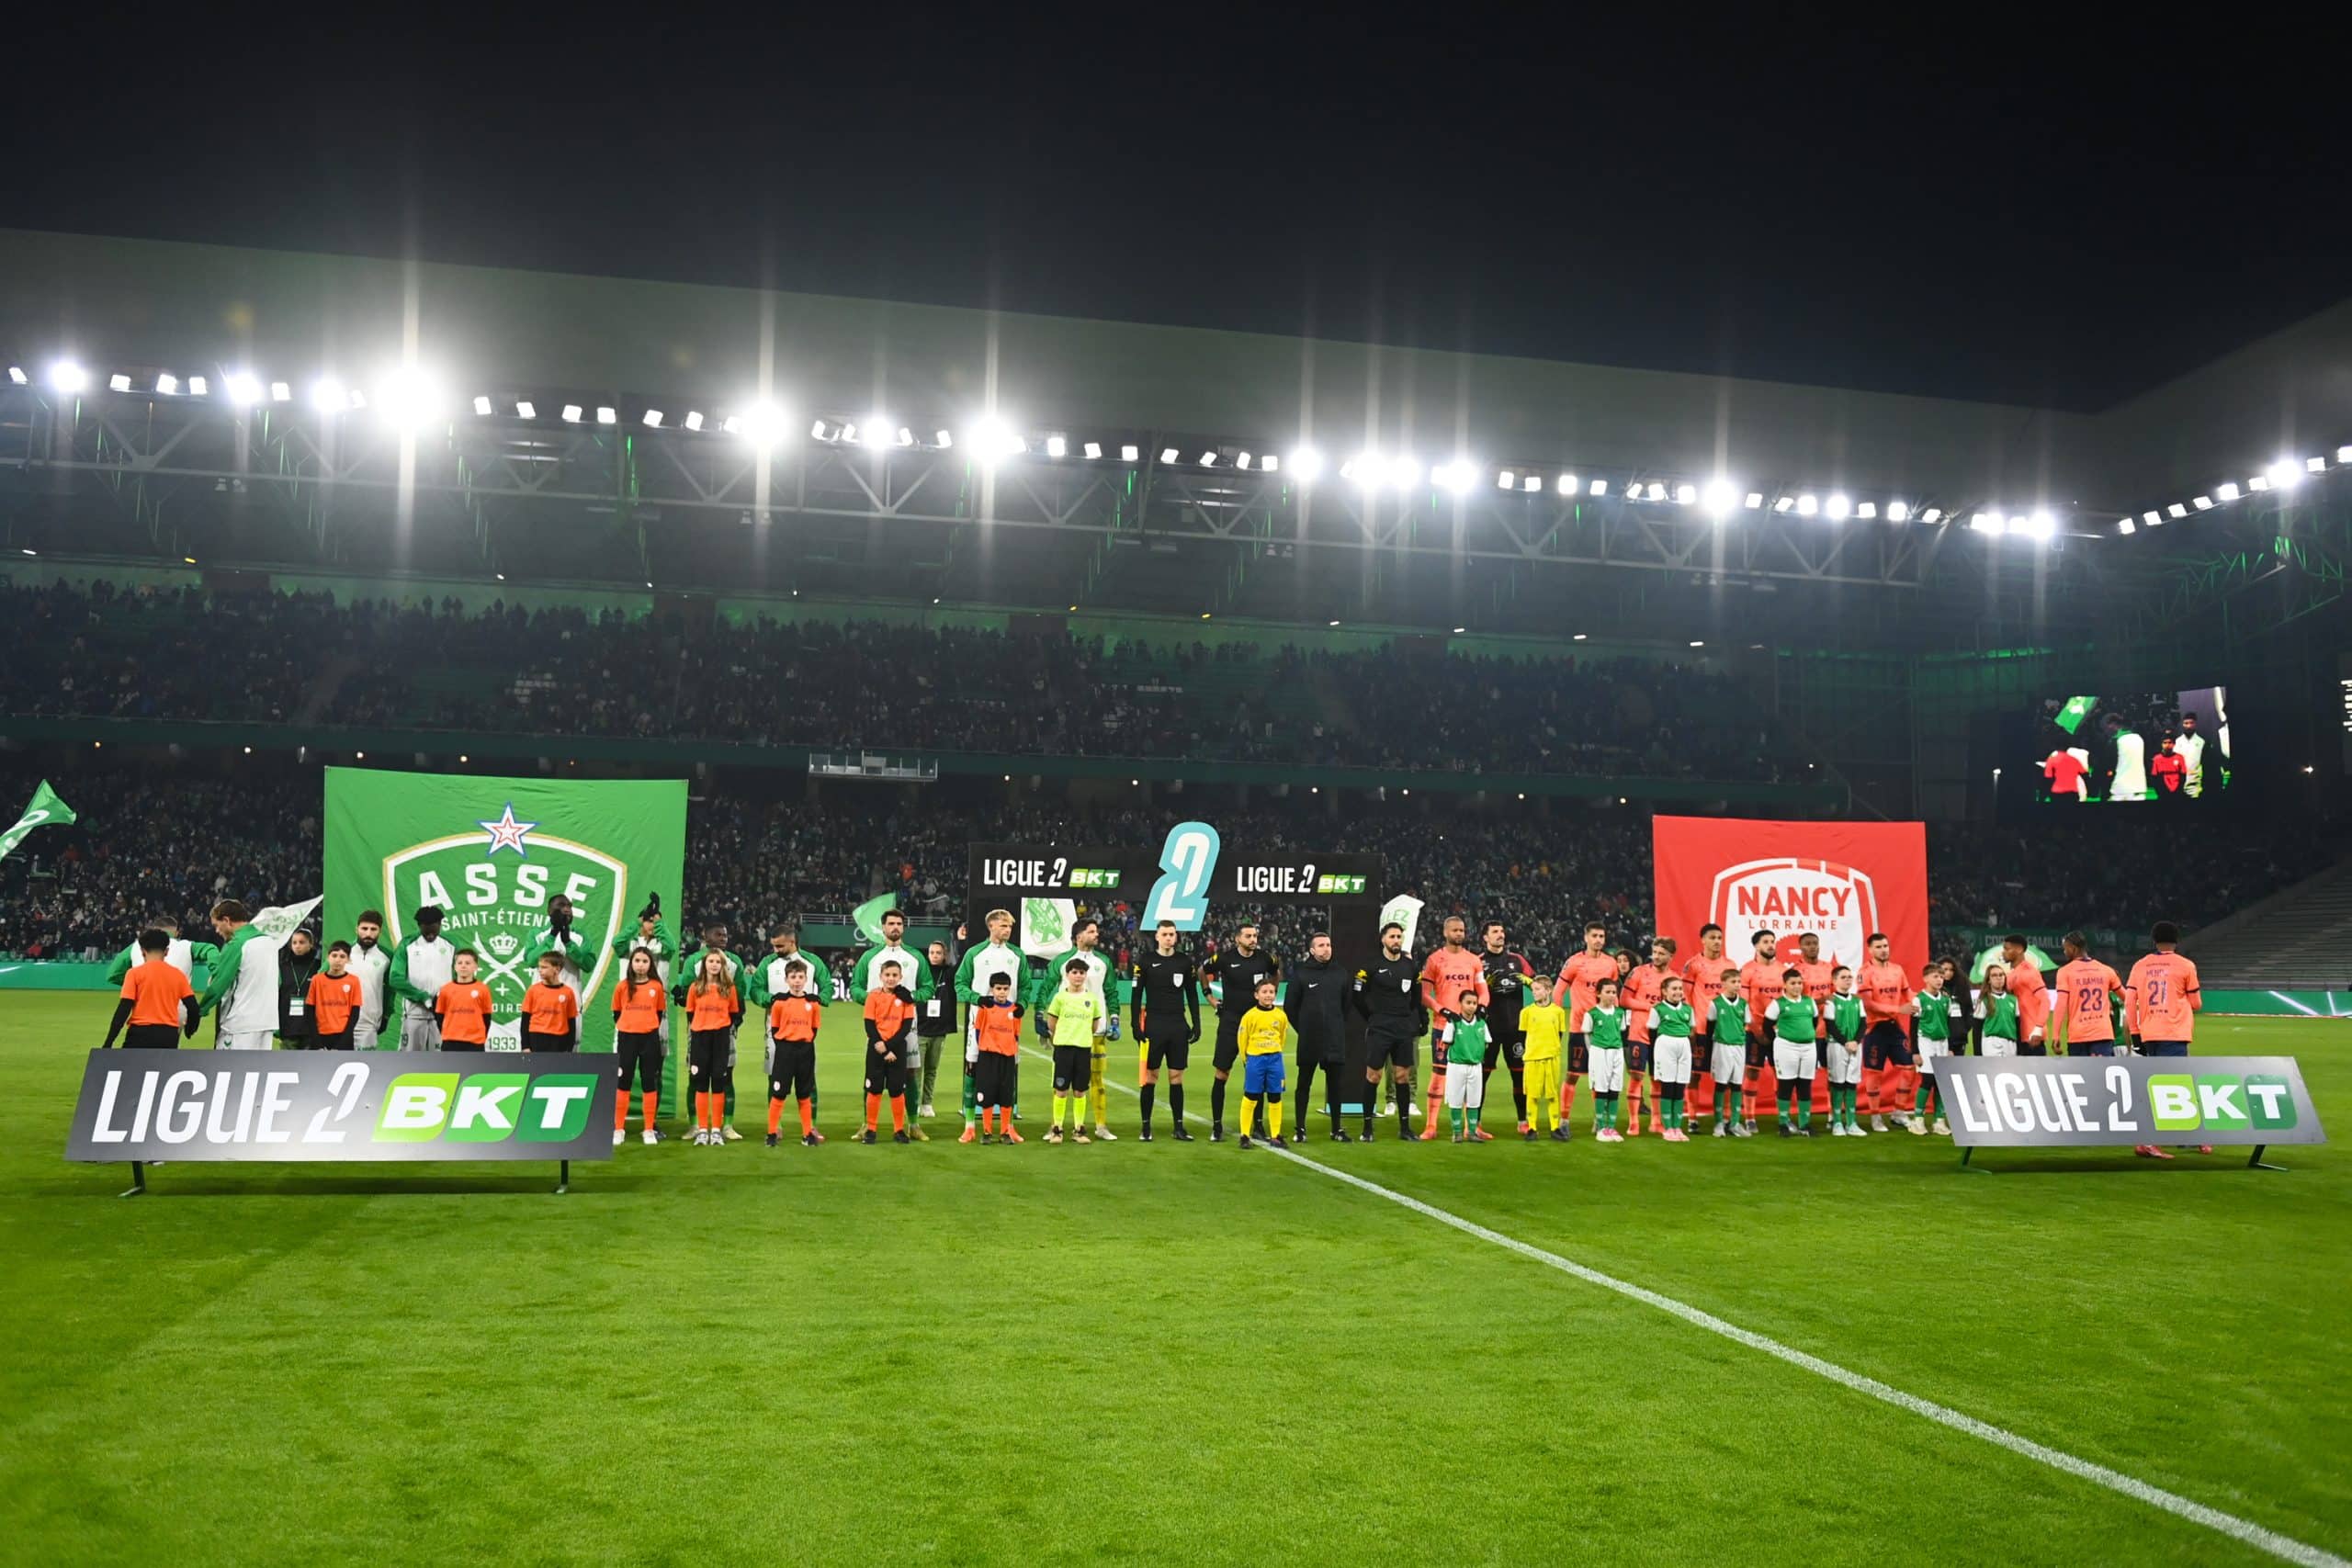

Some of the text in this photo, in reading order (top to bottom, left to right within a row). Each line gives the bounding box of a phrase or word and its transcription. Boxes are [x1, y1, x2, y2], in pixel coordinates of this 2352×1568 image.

[983, 857, 1120, 887] LIGUE 2 BKT
[1237, 863, 1365, 894] LIGUE 2 BKT
[419, 863, 597, 919] ASSE
[1737, 886, 1852, 917] NANCY
[1748, 919, 1838, 931] LORRAINE
[492, 1003, 522, 1013] OIRE
[2079, 987, 2103, 1012] 23
[2147, 980, 2167, 1007] 21
[488, 1037, 517, 1051] 1933
[91, 1062, 589, 1144] LIGUE 2 BKT
[1950, 1065, 2288, 1133] LIGUE 2 BKT
